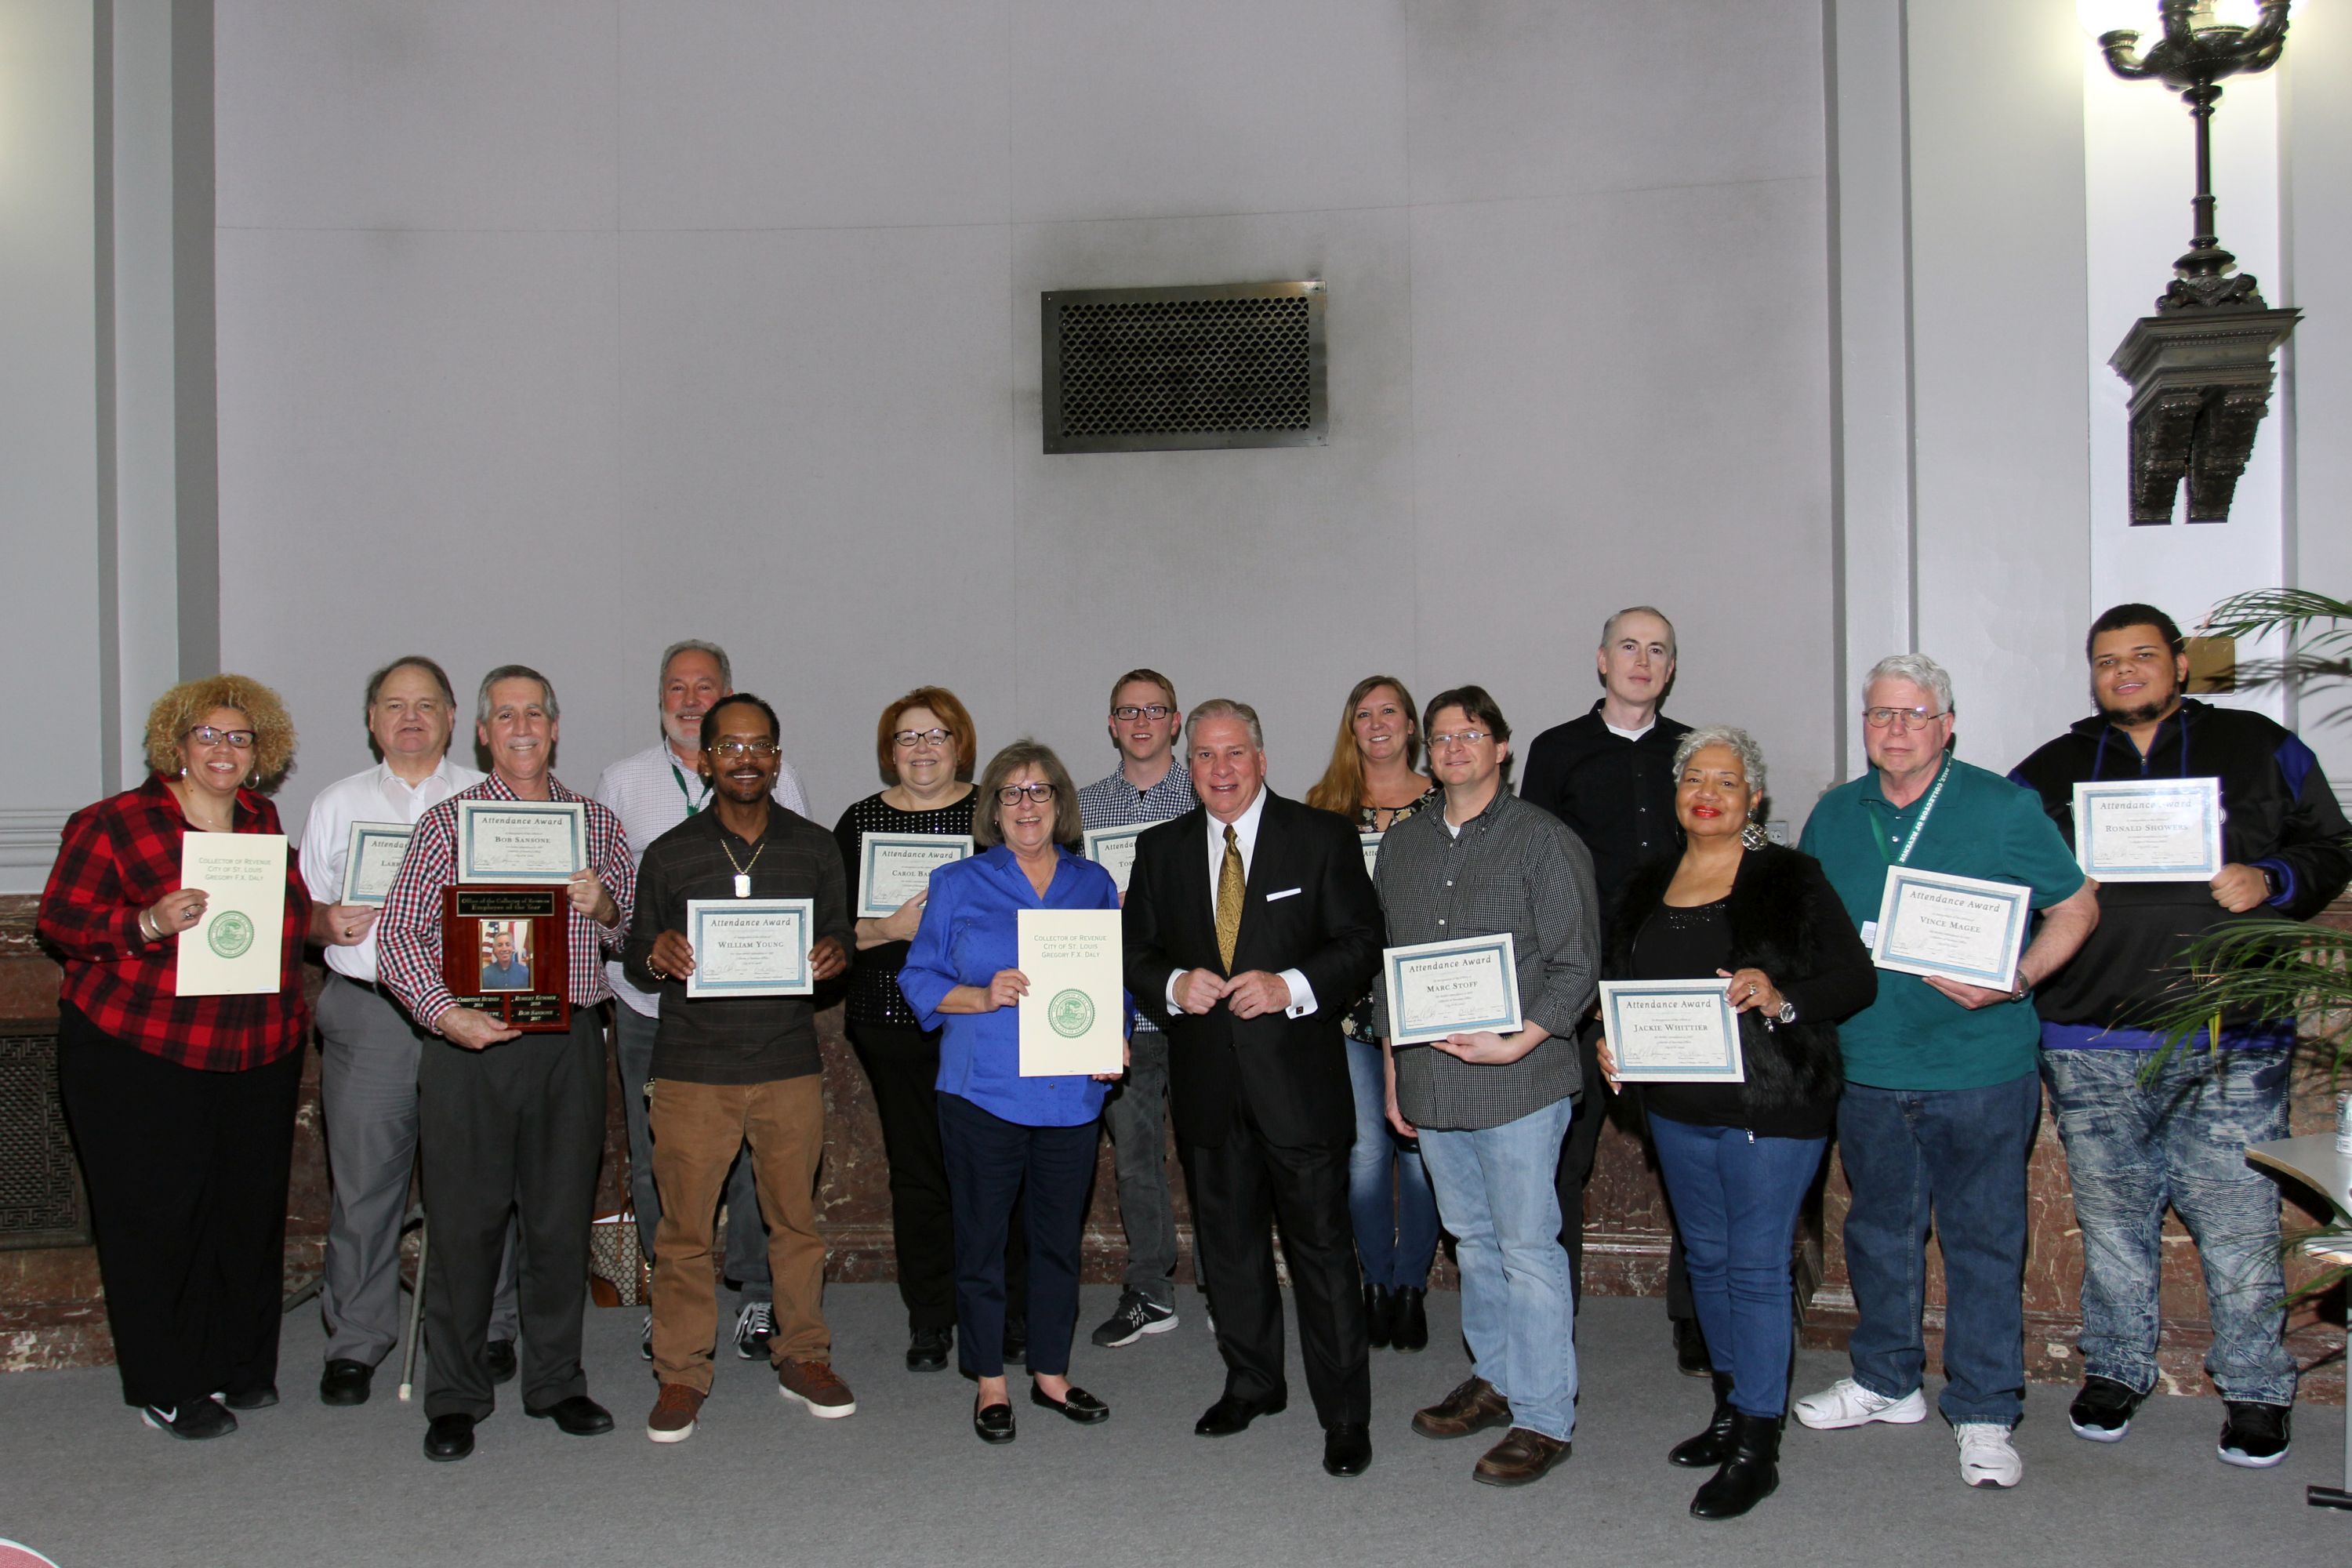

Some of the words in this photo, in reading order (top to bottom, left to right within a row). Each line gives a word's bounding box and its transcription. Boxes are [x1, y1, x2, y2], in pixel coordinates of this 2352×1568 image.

[1919, 782, 1944, 822] COLLECTOR
[2100, 800, 2155, 810] Attendance
[1914, 821, 1926, 834] OF
[2145, 823, 2189, 832] SHOWERS
[1898, 830, 1920, 863] REVENUE
[1909, 891, 1965, 906] Attendance
[1967, 900, 2001, 913] Award
[710, 918, 760, 927] Attendance
[1920, 916, 1947, 928] VINCE
[1949, 920, 1981, 934] MAGEE
[1409, 961, 1459, 973] Attendance
[1462, 955, 1491, 967] Award
[1452, 981, 1478, 989] STOFF
[1626, 1000, 1678, 1009] Attendance
[1680, 999, 1711, 1008] Award
[1633, 1024, 1662, 1033] JACKIE
[1664, 1023, 1708, 1032] WHITTIER
